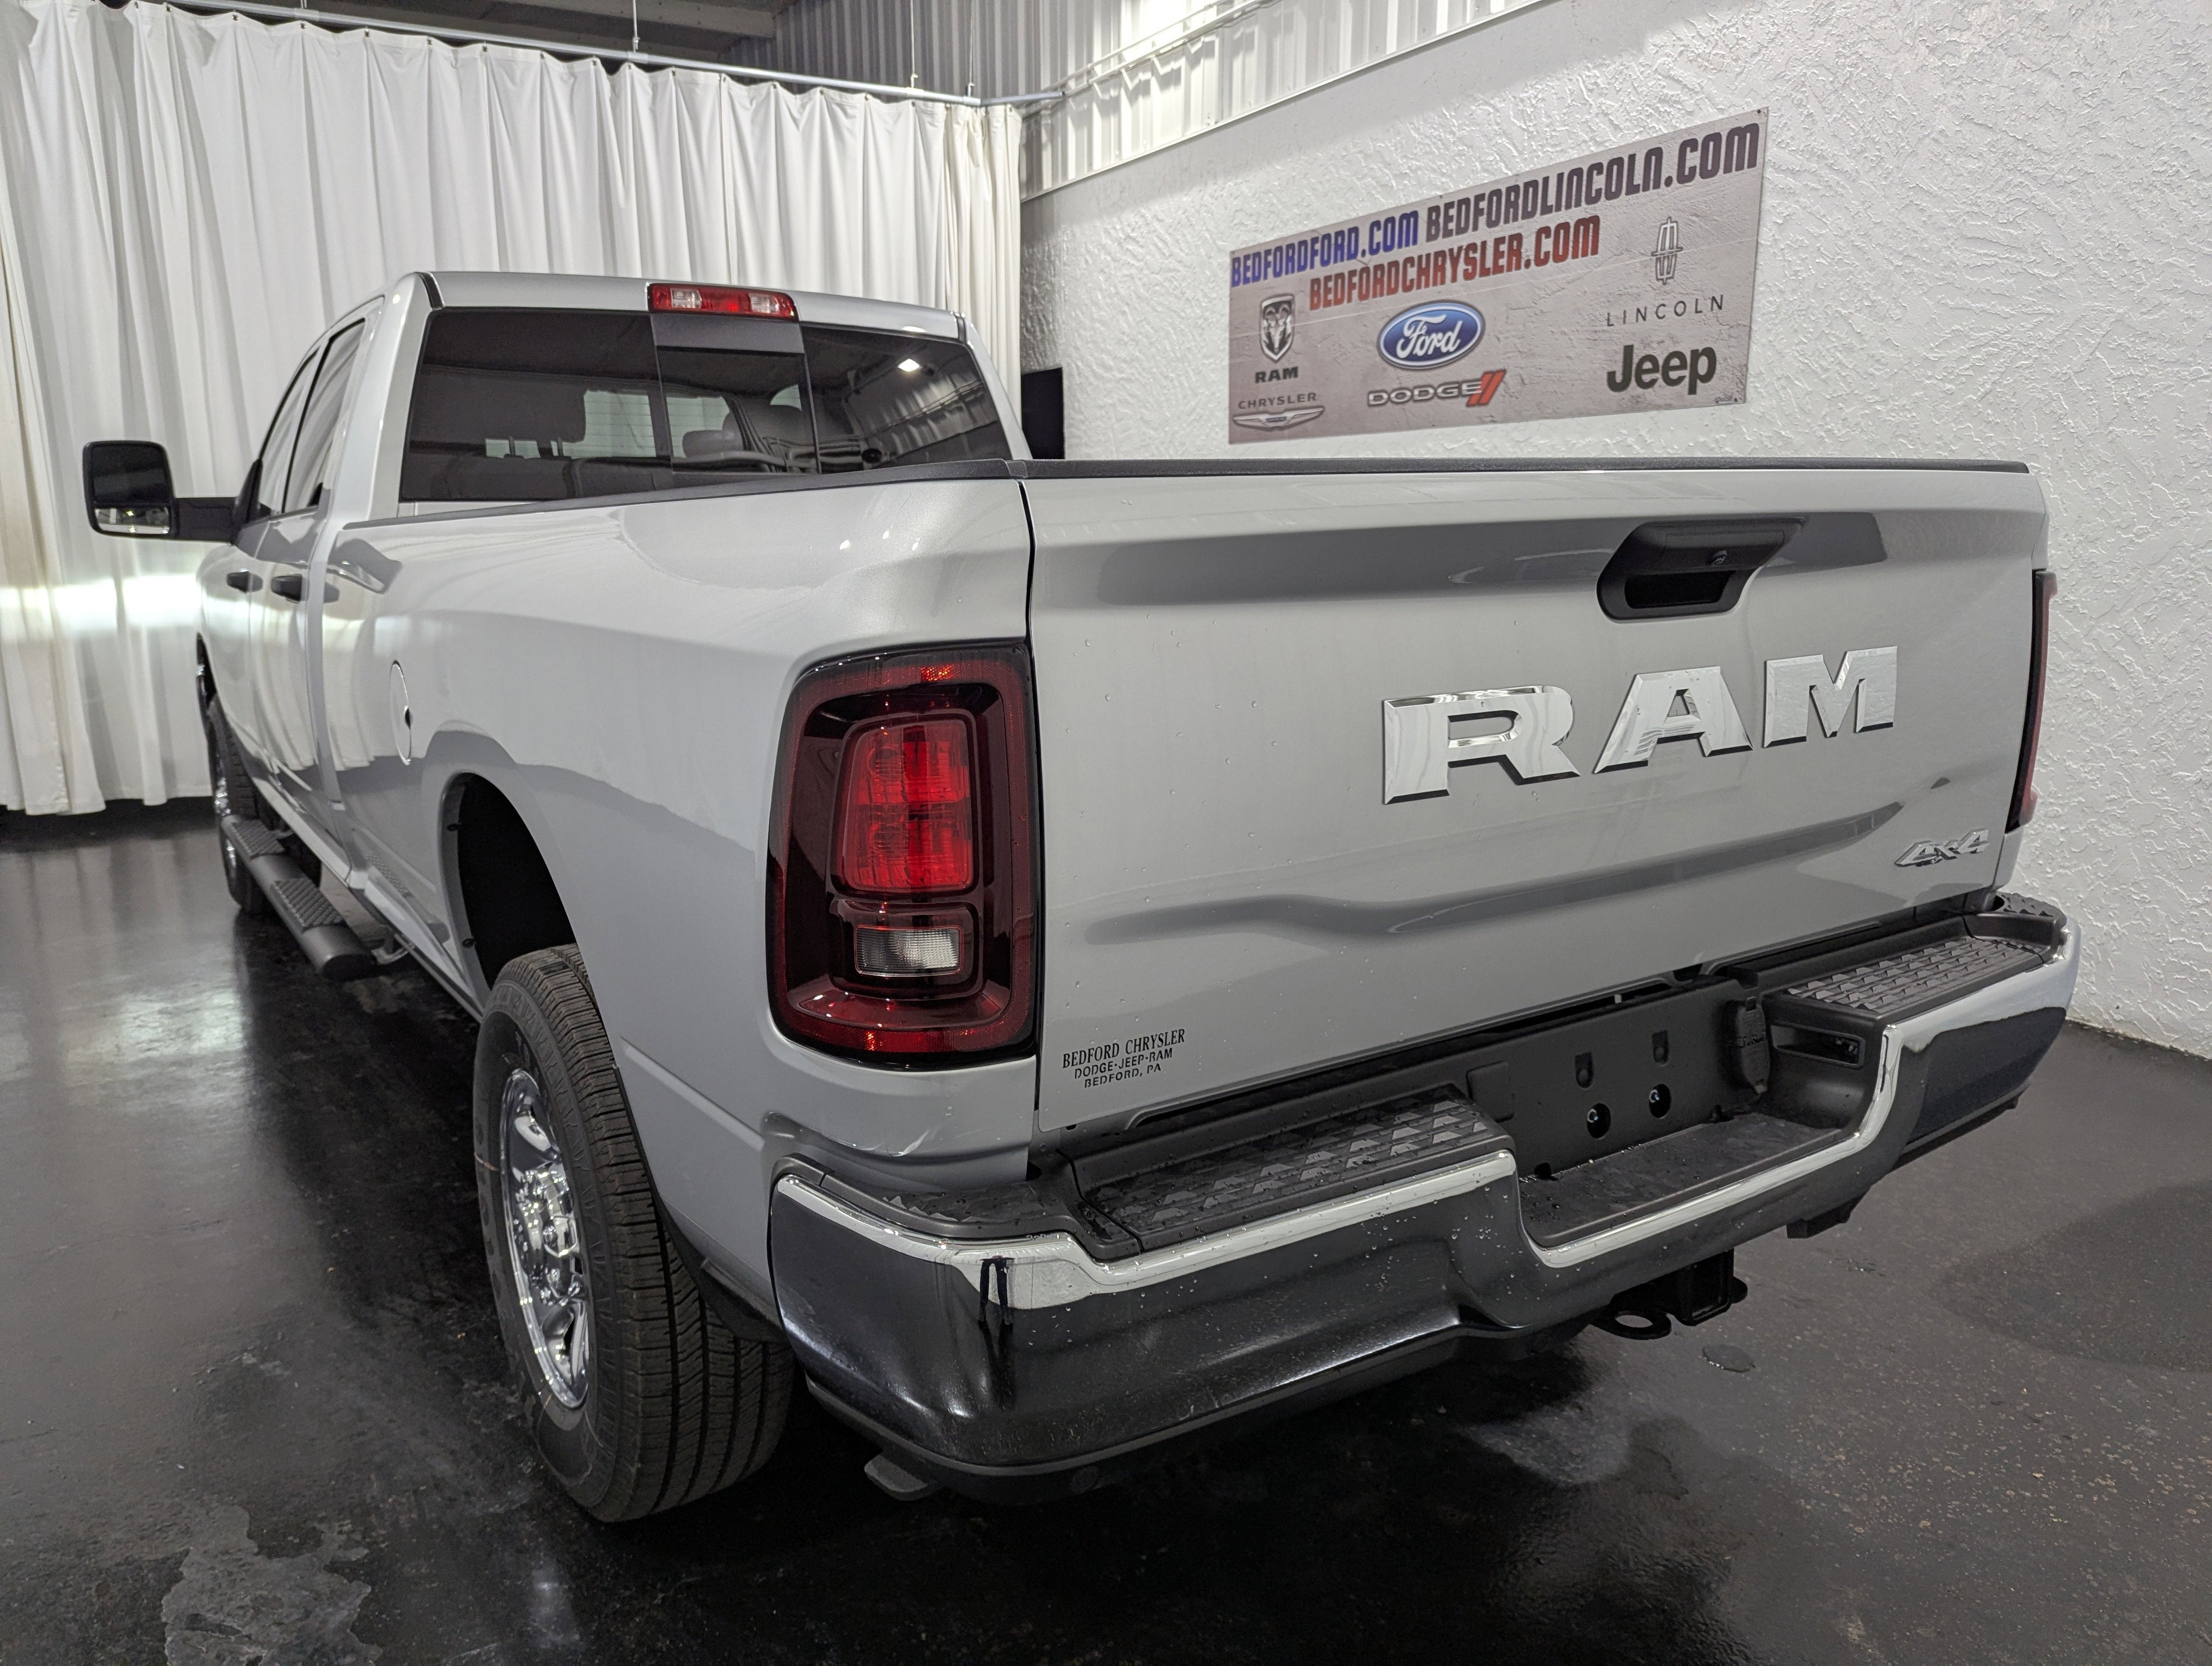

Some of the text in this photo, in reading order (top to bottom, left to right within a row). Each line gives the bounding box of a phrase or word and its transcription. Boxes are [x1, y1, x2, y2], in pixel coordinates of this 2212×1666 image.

[1606, 294, 1725, 327] LINCOLN
[1396, 314, 1463, 358] Ford
[1255, 367, 1298, 384] RAM
[1606, 344, 1717, 395] Jeep
[1238, 392, 1317, 409] CHRYSLER
[1367, 379, 1483, 407] DODGE
[1383, 645, 1898, 805] RAM
[1063, 1029, 1185, 1068] BEDFORD CHRYSLER
[1084, 1063, 1161, 1088] BEDFORD, PA
